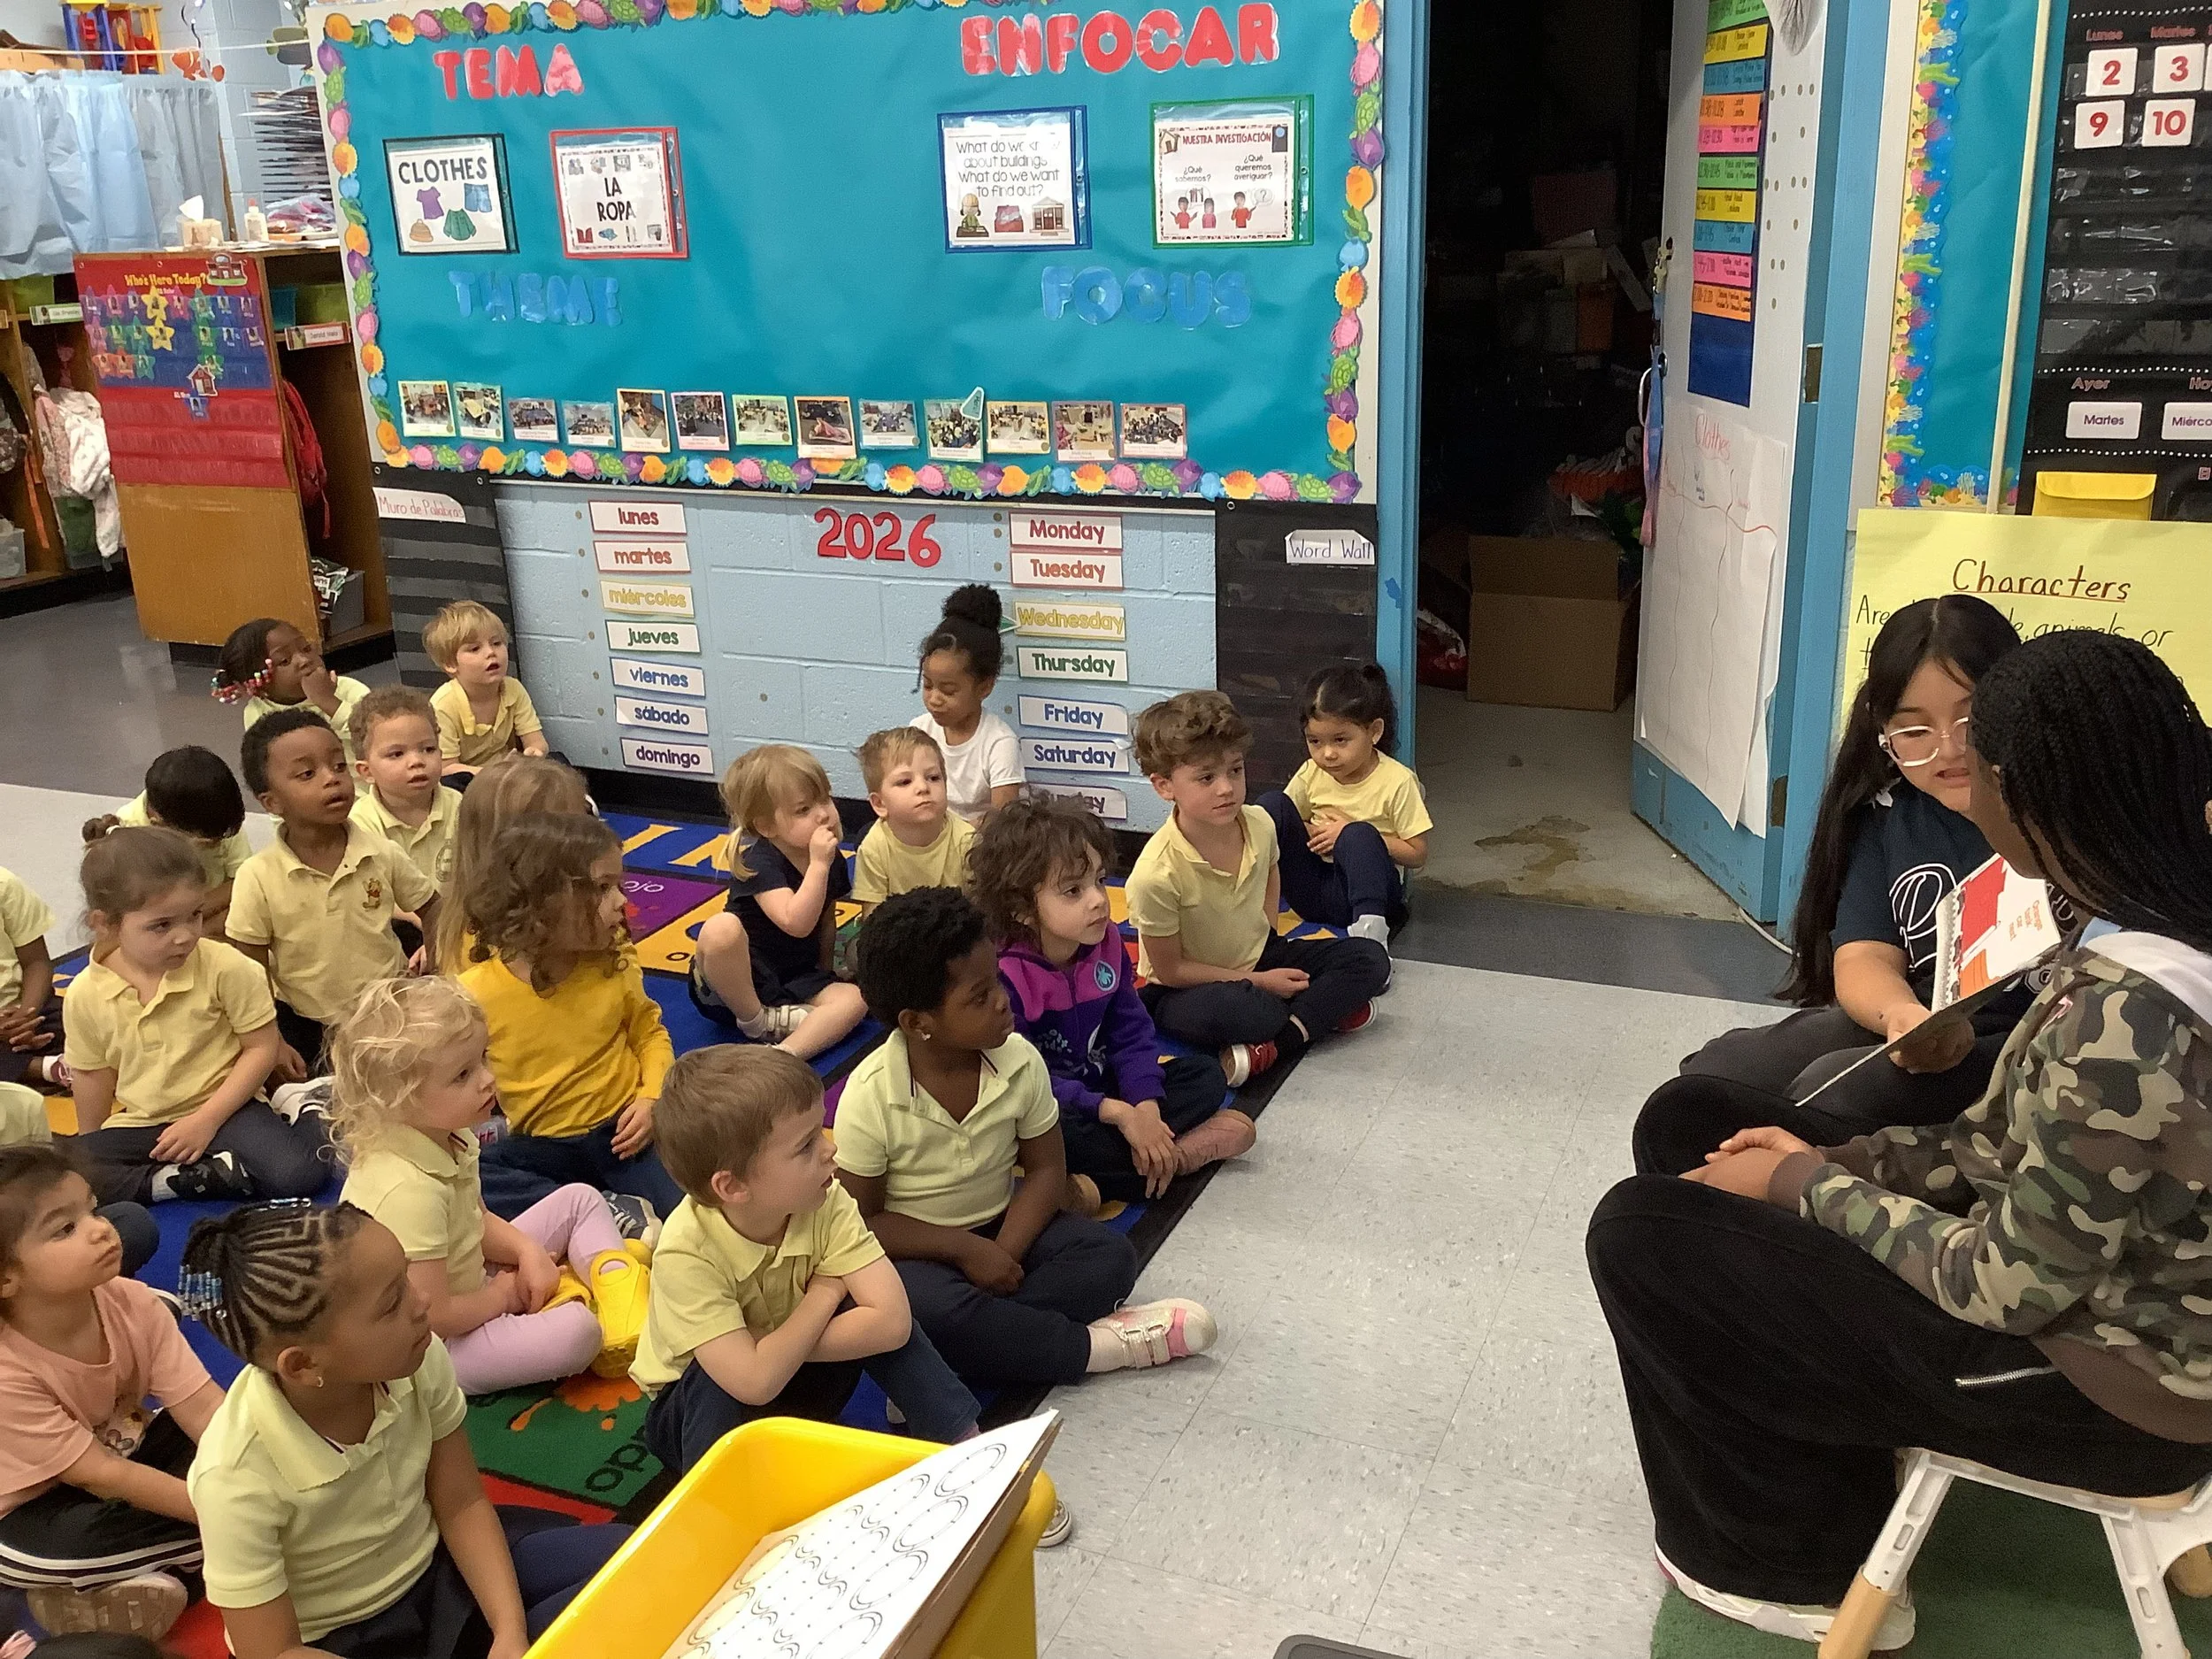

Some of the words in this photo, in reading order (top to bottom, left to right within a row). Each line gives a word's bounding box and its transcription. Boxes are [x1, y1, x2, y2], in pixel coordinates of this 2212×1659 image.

[961, 3, 1280, 76] ENFOCAR
[433, 43, 584, 100] TEMA
[2102, 60, 2122, 86] 2
[2170, 56, 2189, 82] 3
[2089, 111, 2108, 137] 9
[2153, 110, 2186, 136] 10
[956, 141, 987, 154] What
[990, 141, 1006, 152] do
[1183, 134, 1213, 145] NUESTRA
[1216, 132, 1271, 144] INVESTIGACIÓN
[964, 156, 998, 168] about
[1183, 165, 1202, 175] ¿Qué
[1235, 165, 1271, 173] queremos
[1243, 154, 1263, 164] ¿Qué
[398, 157, 488, 186] CLOTHES
[958, 172, 990, 183] What
[993, 170, 1008, 182] do
[1010, 172, 1028, 182] we
[1030, 169, 1060, 181] want
[1233, 172, 1273, 182] averiguar?
[604, 177, 622, 197] LA
[976, 185, 989, 197] to
[991, 184, 1015, 197] find
[1017, 184, 1044, 197] out?
[596, 200, 636, 222] ROPA
[173, 272, 206, 288] Today?
[449, 269, 621, 326] THEME
[1041, 266, 1251, 329] FOCUS
[2071, 377, 2110, 391] Ayer
[2189, 377, 2212, 392] Ho
[2084, 414, 2124, 426] Martes
[1694, 413, 1732, 461] Clothes
[379, 495, 411, 516] Muro
[411, 499, 423, 517] de
[422, 499, 465, 519] Palabras
[618, 507, 660, 526] lunes
[814, 508, 941, 567] 2026
[1029, 518, 1105, 544] Monday
[614, 548, 672, 565] martes
[1290, 539, 1332, 559] Word
[1340, 539, 1371, 560] Wall
[1030, 558, 1106, 583] Tuesday
[1953, 558, 2131, 600] Characters
[609, 588, 687, 608] miércoles
[1018, 607, 1125, 635] Wednesday
[1856, 595, 1890, 626] Are
[2141, 629, 2174, 647] or
[627, 621, 680, 647] jueves
[1032, 653, 1116, 678] Thursday
[629, 667, 689, 688] viernes
[634, 705, 690, 726] sábado
[1044, 703, 1104, 729] Friday
[636, 745, 701, 768] domingo
[1033, 745, 1117, 768] Saturday
